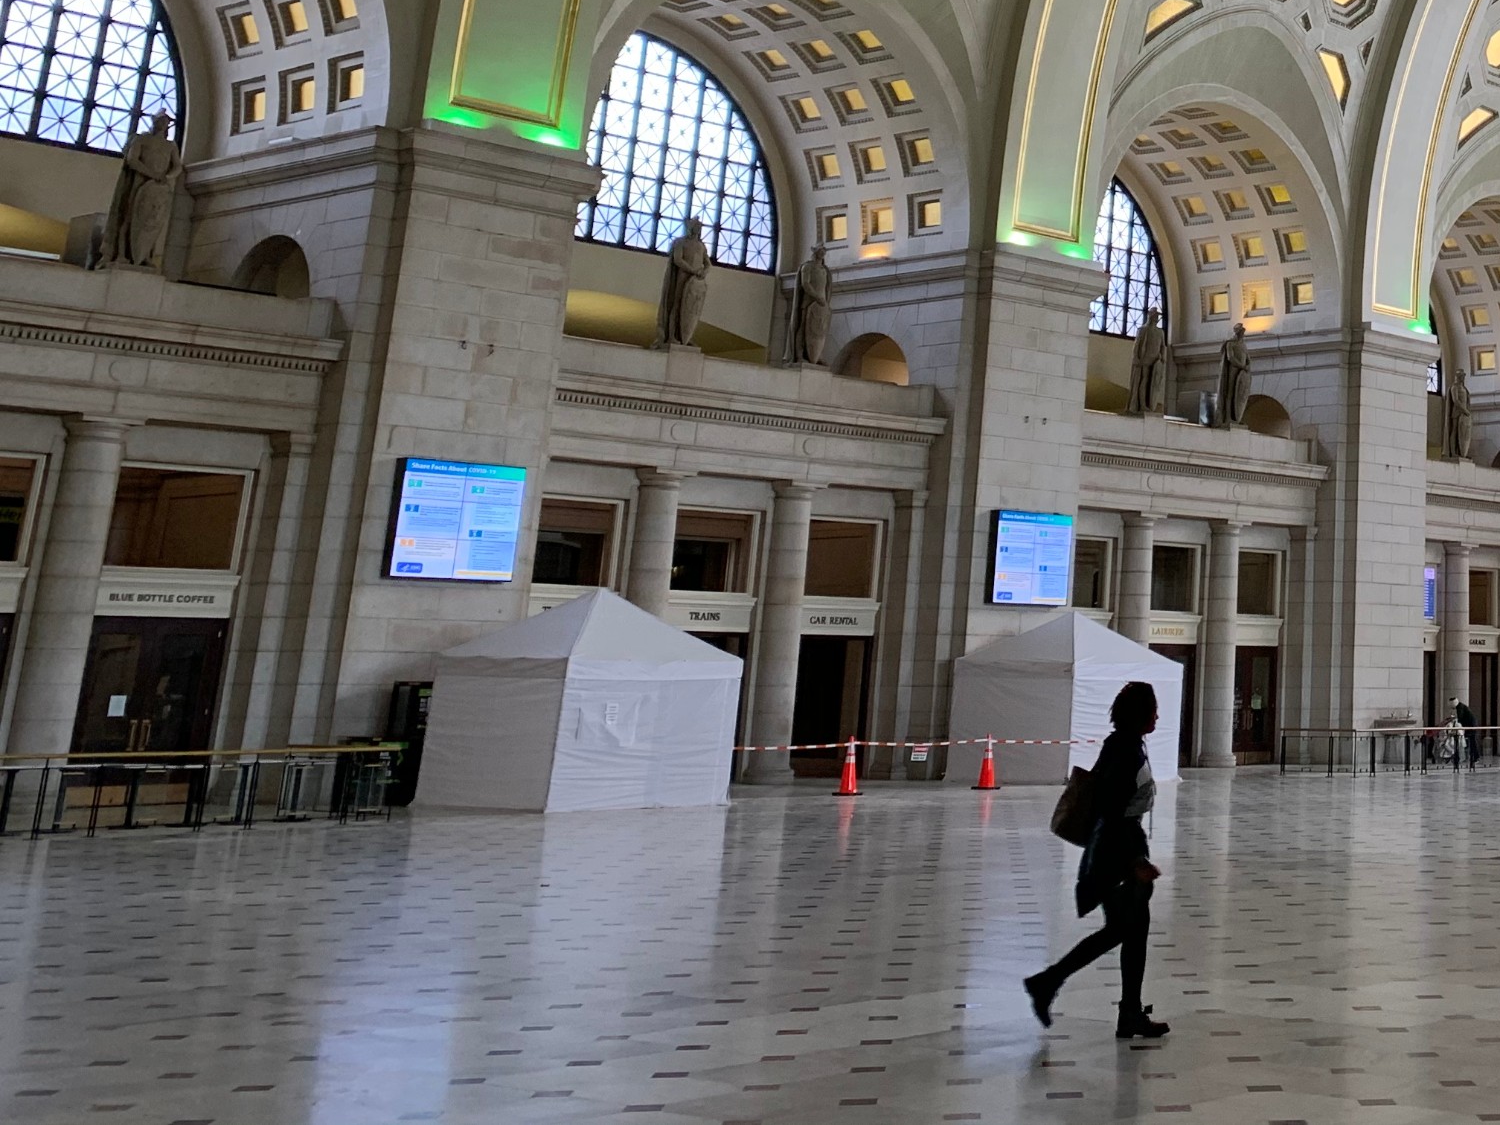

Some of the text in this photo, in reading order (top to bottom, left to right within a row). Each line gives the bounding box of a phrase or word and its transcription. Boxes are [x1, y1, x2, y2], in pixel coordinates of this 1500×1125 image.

[411, 462, 430, 470] Share
[431, 463, 447, 471] Facts
[109, 593, 216, 604] BLUE BOTTLE COFFEE
[689, 612, 720, 621] TRAINS
[809, 616, 858, 626] CAR RENTAL
